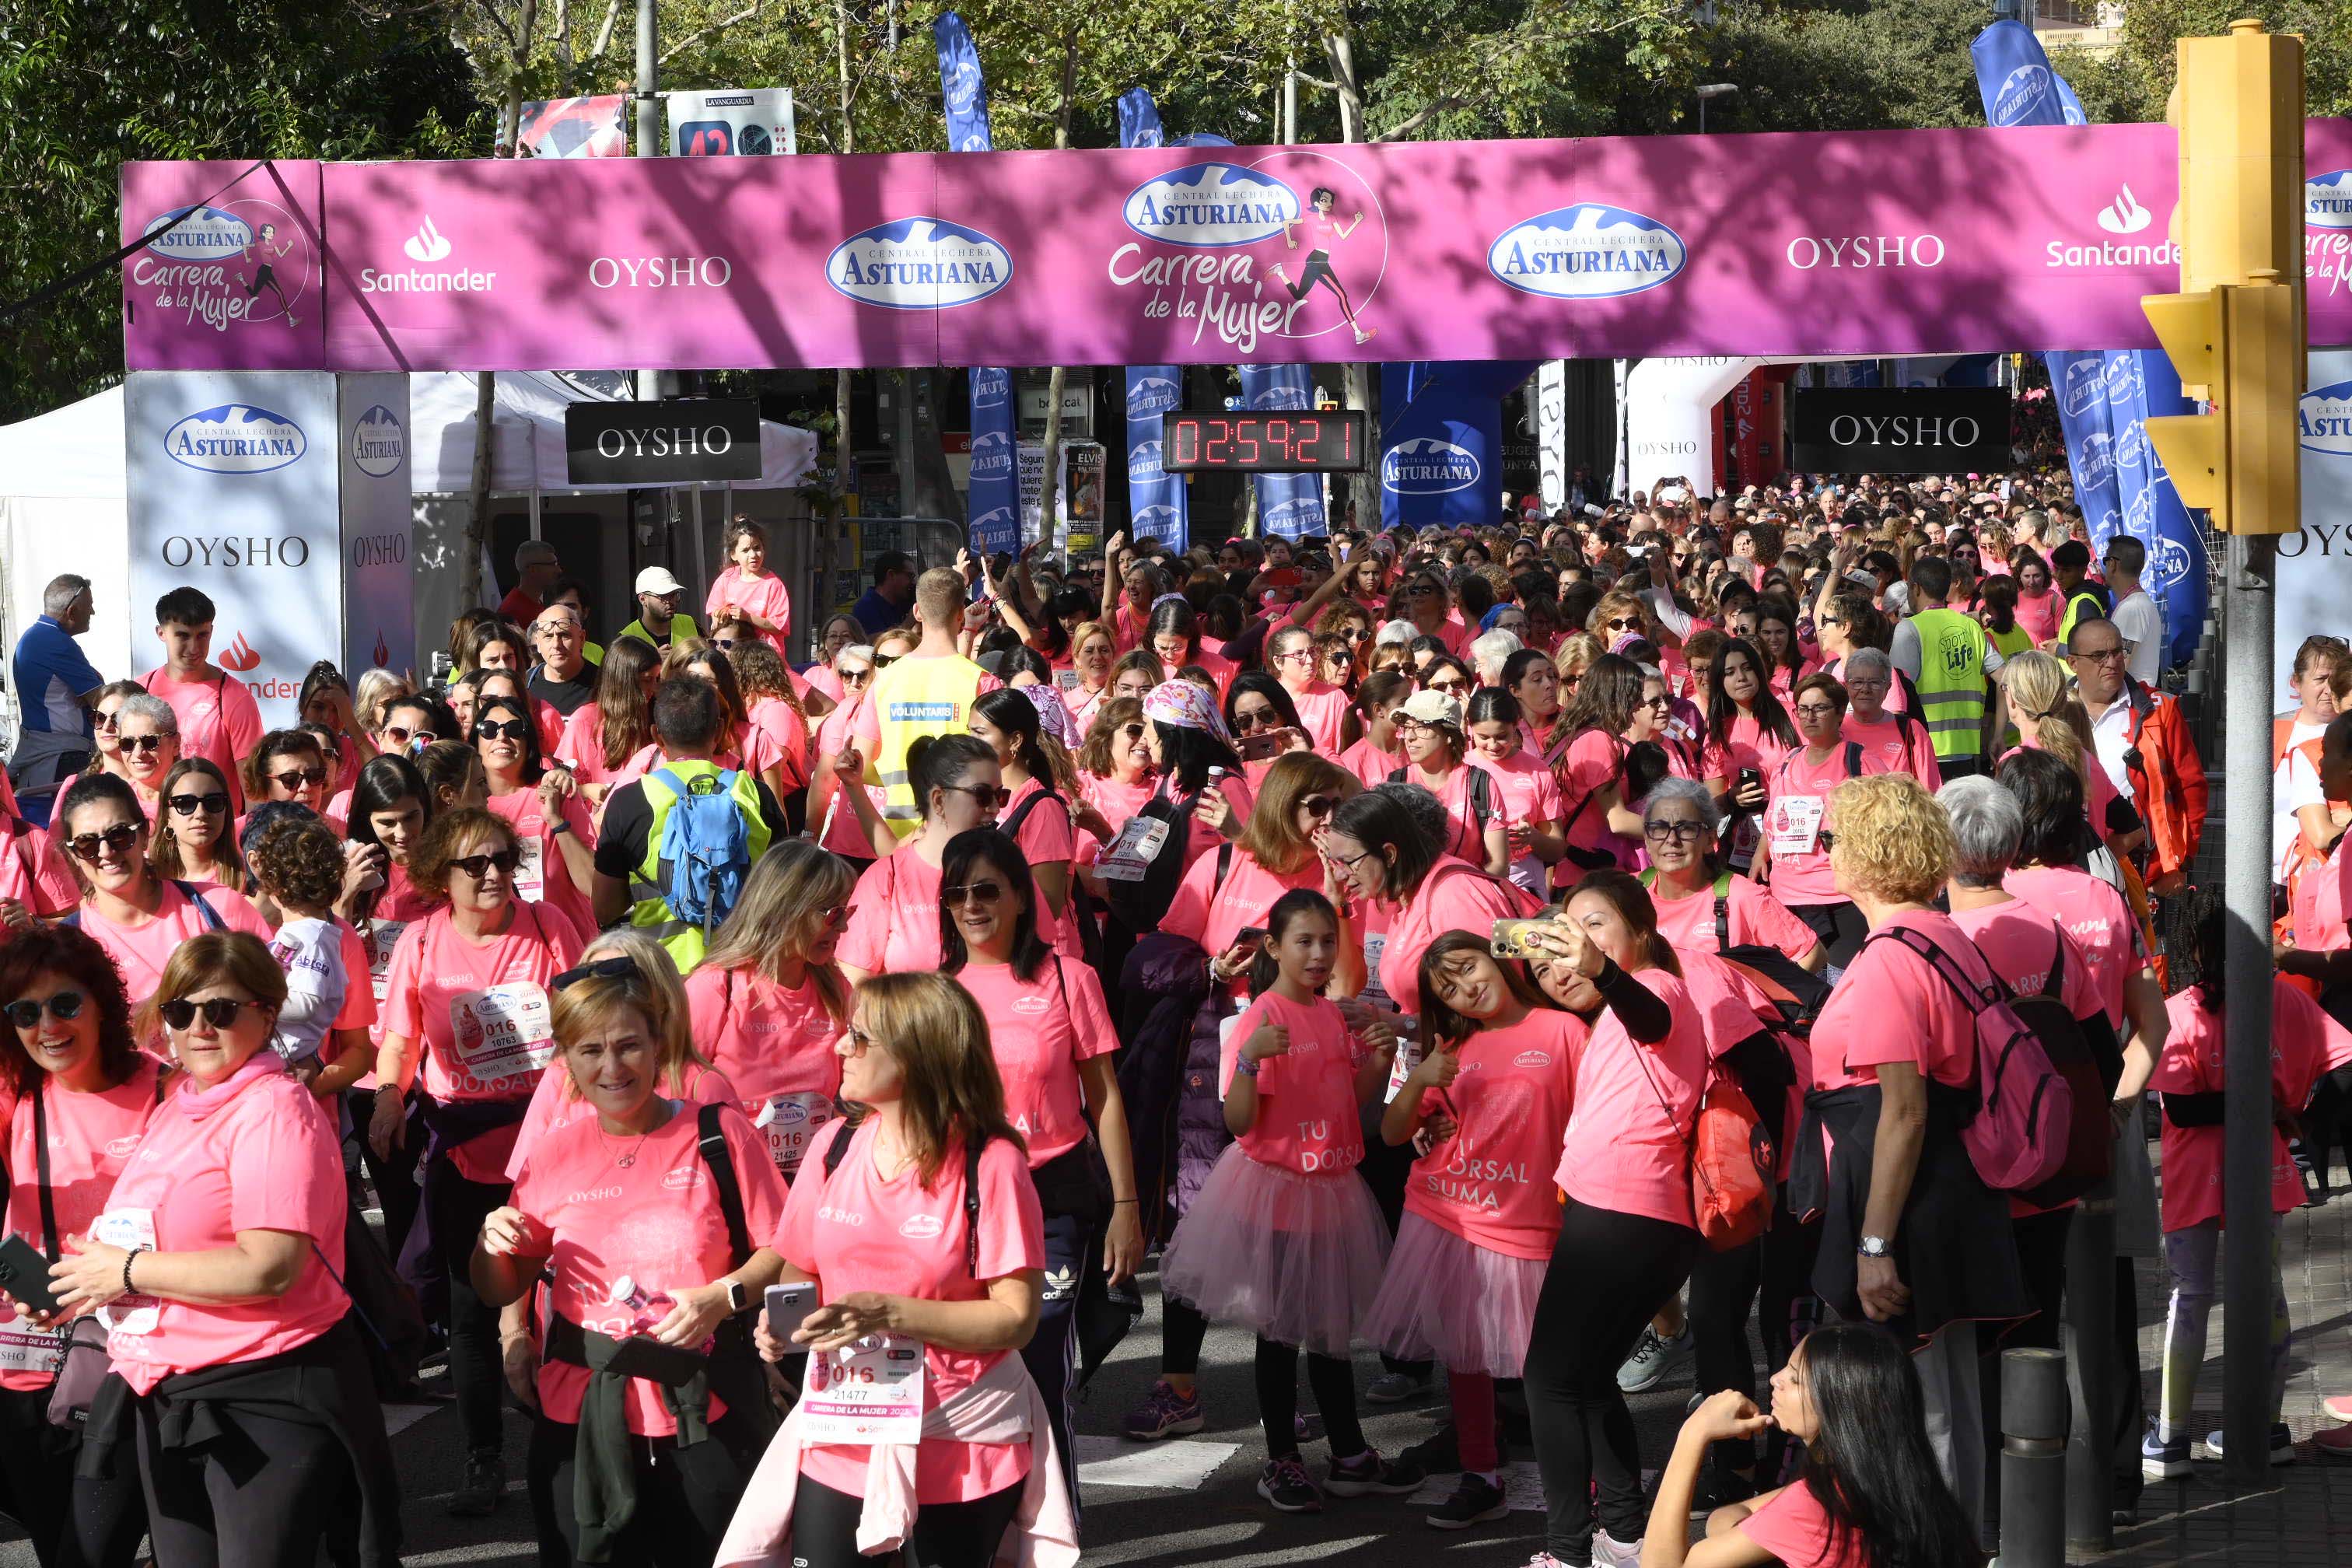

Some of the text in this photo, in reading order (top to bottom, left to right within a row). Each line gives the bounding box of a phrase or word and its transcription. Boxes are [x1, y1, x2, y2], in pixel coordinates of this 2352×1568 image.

[715, 96, 753, 106] VANGUARDIA
[1164, 190, 1282, 201] CENTRAL LECHERA
[2305, 198, 2352, 214] STUR
[1136, 194, 1286, 227] ASTURIANA
[152, 226, 245, 247] ASTURIANA
[1534, 235, 1664, 247] CENTRAL LECHERA
[869, 248, 992, 258] CENTRAL LECHERA
[1503, 240, 1671, 275] ASTURIANA
[1787, 233, 1945, 270] OYSHO
[2046, 240, 2182, 268] Santande
[133, 257, 225, 286] Carrera
[589, 256, 731, 289] OYSHO
[840, 251, 999, 285] ASTURIANA
[1108, 242, 1255, 286] Carrera
[2319, 254, 2333, 278] la
[360, 268, 496, 292] Santander
[156, 284, 260, 332] de la Mujer
[1144, 279, 1309, 354] de la Mujer
[175, 429, 297, 457] ASTURIANA
[197, 427, 292, 436] CENTRAL LECHERA
[597, 425, 733, 459] OYSHO
[1176, 420, 1349, 463] 02:59:21
[1829, 415, 1980, 447] OYSHO
[355, 432, 401, 460] ASTURIANA
[1637, 440, 1697, 455] OYSHO
[1078, 453, 1102, 464] ELVIS
[1020, 475, 1044, 485] quiere
[1384, 460, 1473, 483] ASTURIANA
[162, 535, 310, 569] OYSHO
[354, 533, 405, 568] OYSHO
[1940, 628, 1969, 654] Sport
[1946, 643, 1972, 670] Life
[890, 706, 952, 717] VOLUNTARIS
[485, 1019, 516, 1036] 016
[491, 1035, 516, 1048] 10763
[771, 1132, 803, 1147] 016
[1297, 1118, 1327, 1143] TU
[774, 1150, 797, 1160] 21425
[1445, 1157, 1530, 1185] ORSAL
[569, 1186, 621, 1203] OYSHO
[1426, 1174, 1500, 1209] SUMA
[1042, 1289, 1076, 1300] adidas
[1, 1351, 26, 1362] SHO
[832, 1365, 875, 1383] 016
[834, 1389, 868, 1401] 21477
[835, 1405, 847, 1414] DE
[859, 1406, 888, 1415] MUJER
